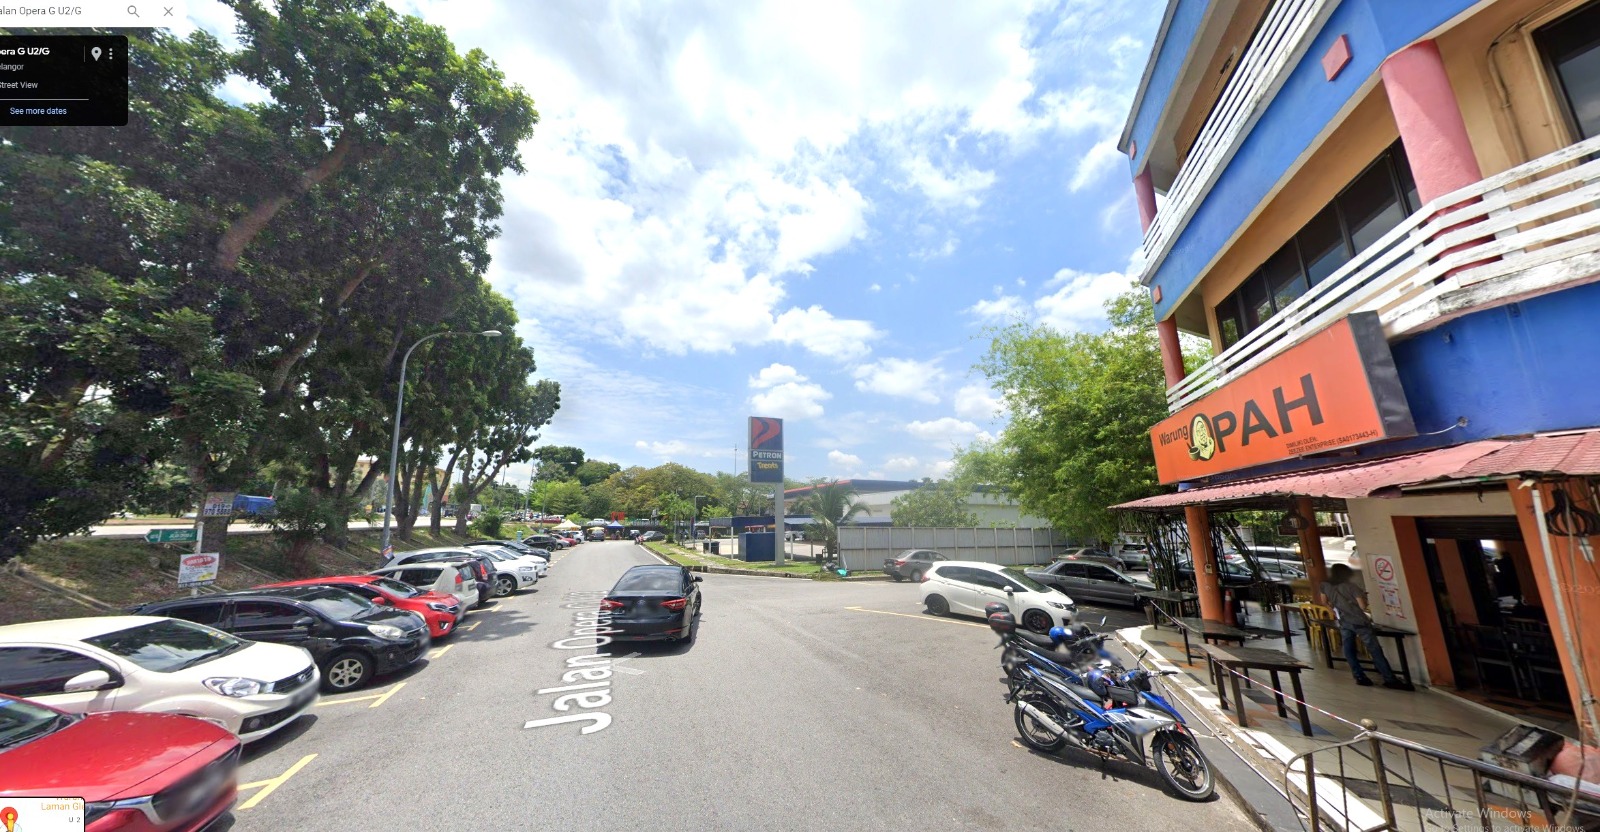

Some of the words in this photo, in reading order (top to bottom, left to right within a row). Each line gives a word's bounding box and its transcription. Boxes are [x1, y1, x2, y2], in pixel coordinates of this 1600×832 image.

[1159, 425, 1189, 446] Warung
[1189, 372, 1325, 461] OPAH
[1305, 439, 1337, 452] ENTERPRISE
[752, 450, 782, 459] PETRON
